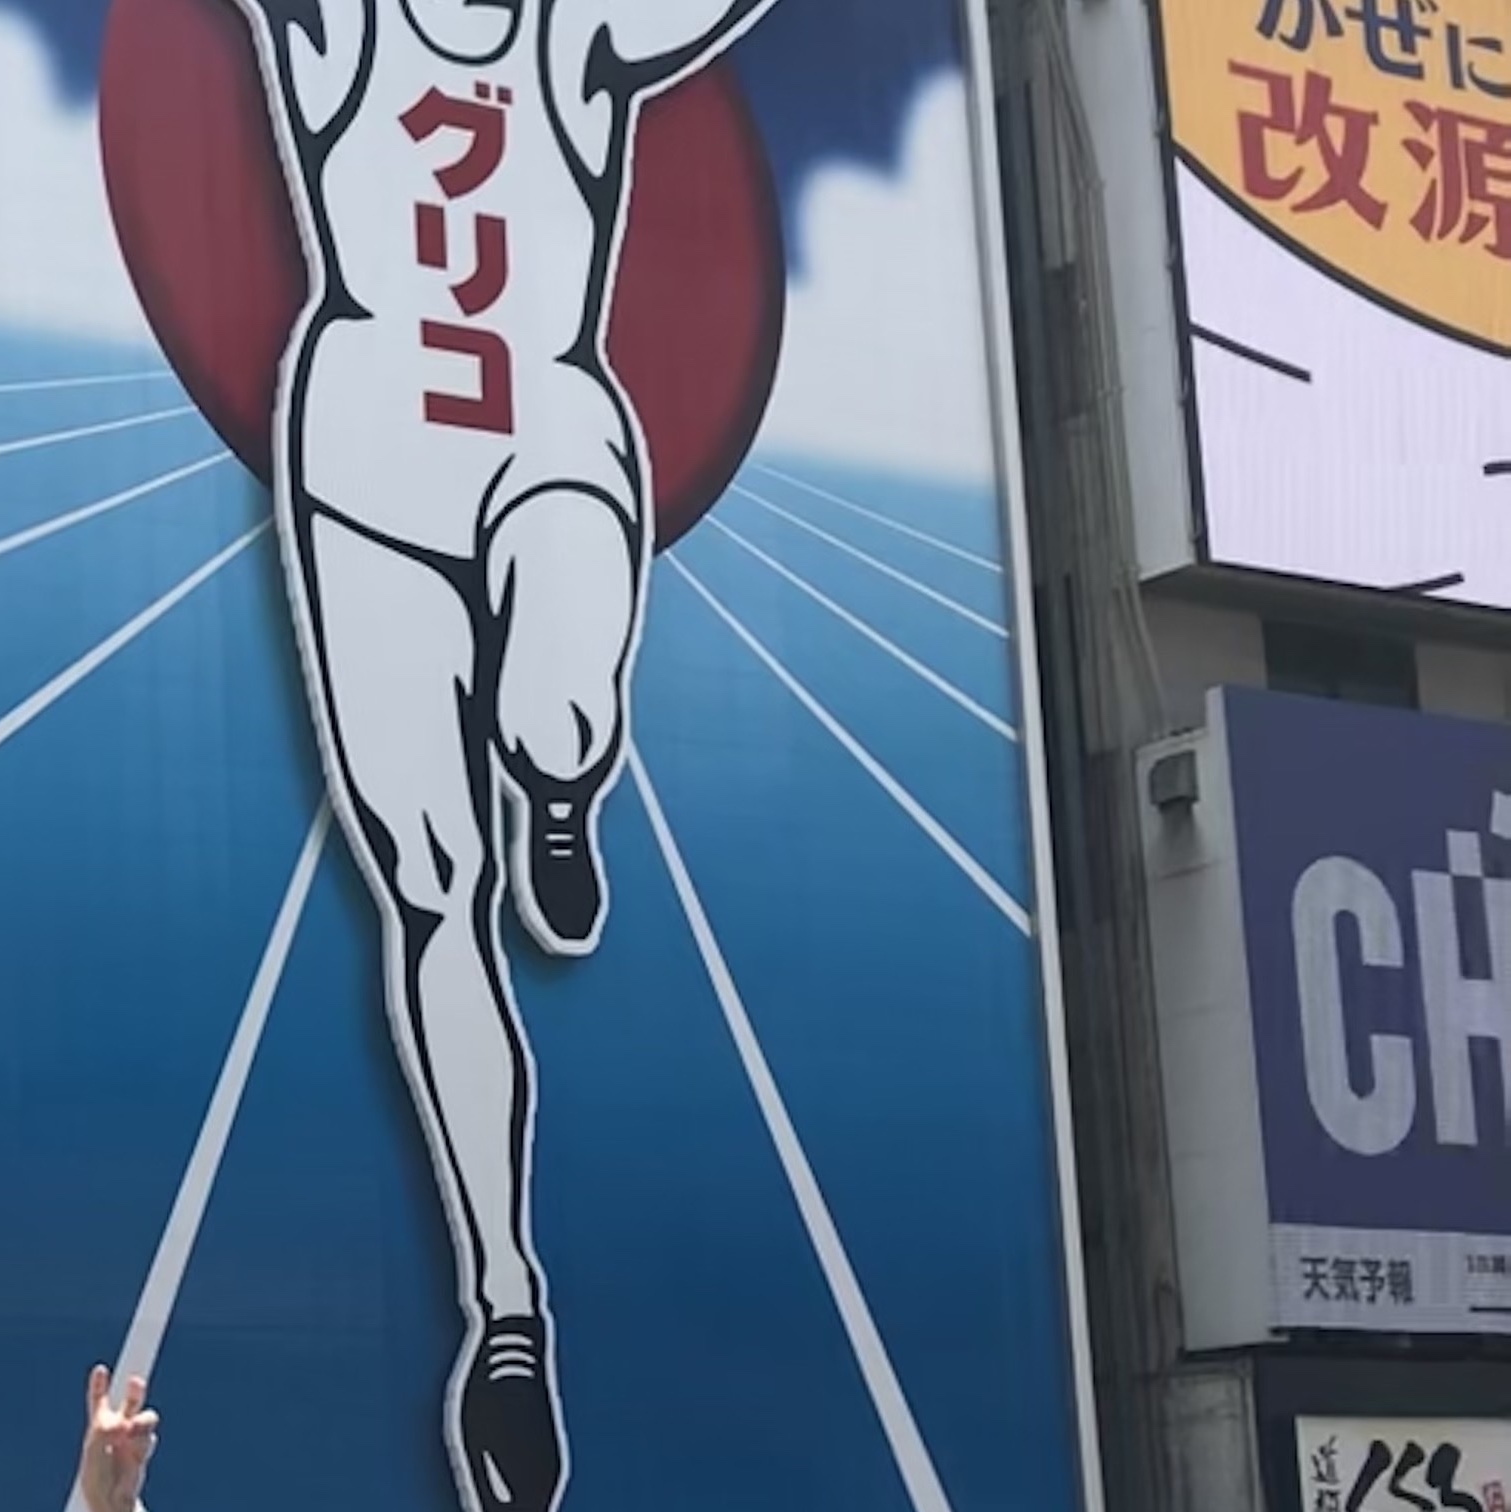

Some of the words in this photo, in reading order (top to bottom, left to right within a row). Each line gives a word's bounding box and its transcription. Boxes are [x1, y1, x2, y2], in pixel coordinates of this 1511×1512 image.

[398, 80, 515, 436] グリコ
[1227, 59, 1511, 260] 改源
[1300, 1256, 1415, 1304] 天気予報
